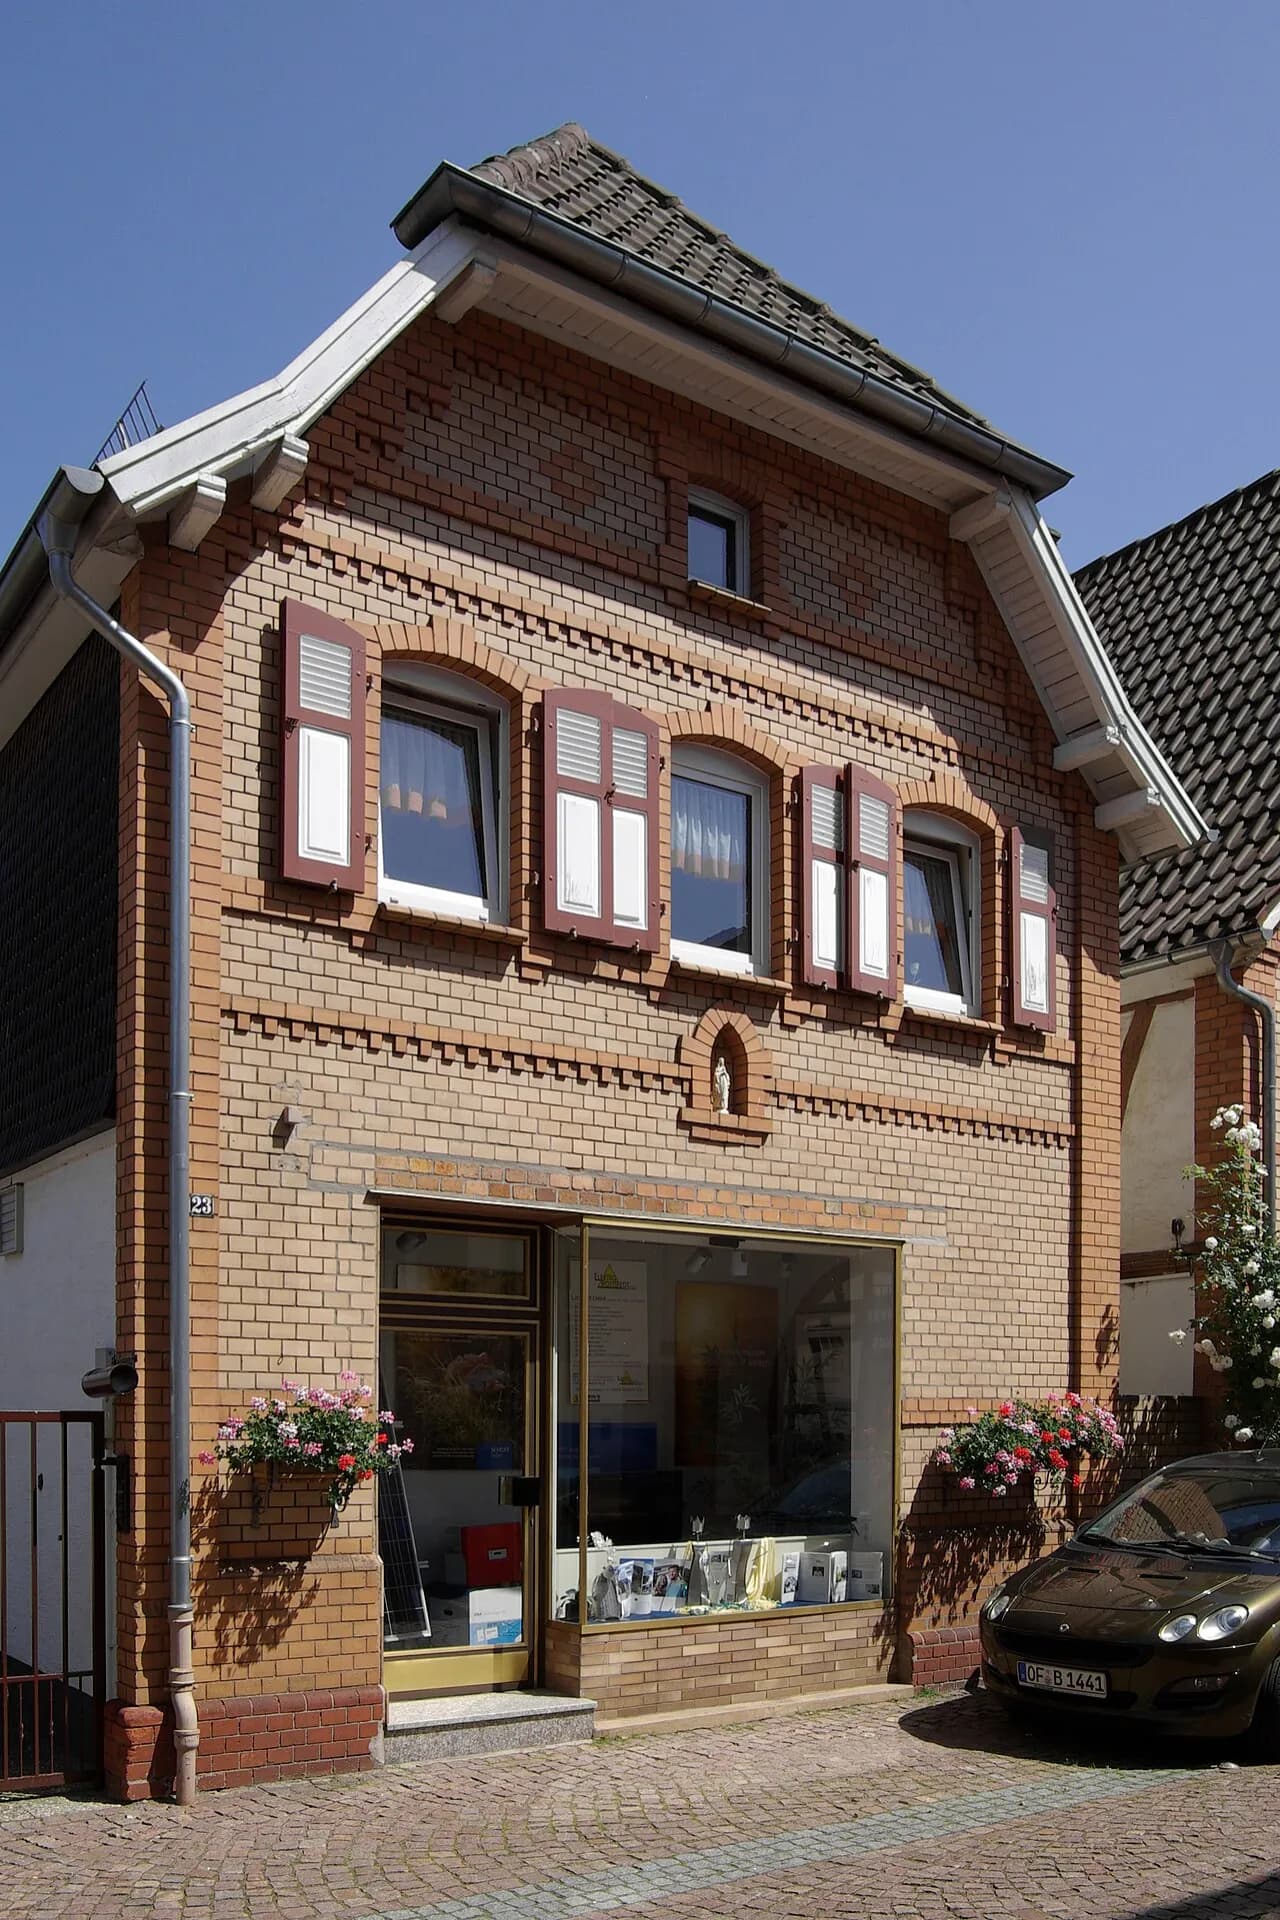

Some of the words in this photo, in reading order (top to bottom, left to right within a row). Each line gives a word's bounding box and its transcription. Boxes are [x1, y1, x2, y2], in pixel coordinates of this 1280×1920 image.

[191, 1195, 212, 1214] 23
[1027, 1665, 1044, 1682] OF
[1053, 1670, 1063, 1686] B
[1066, 1672, 1105, 1692] 1441
